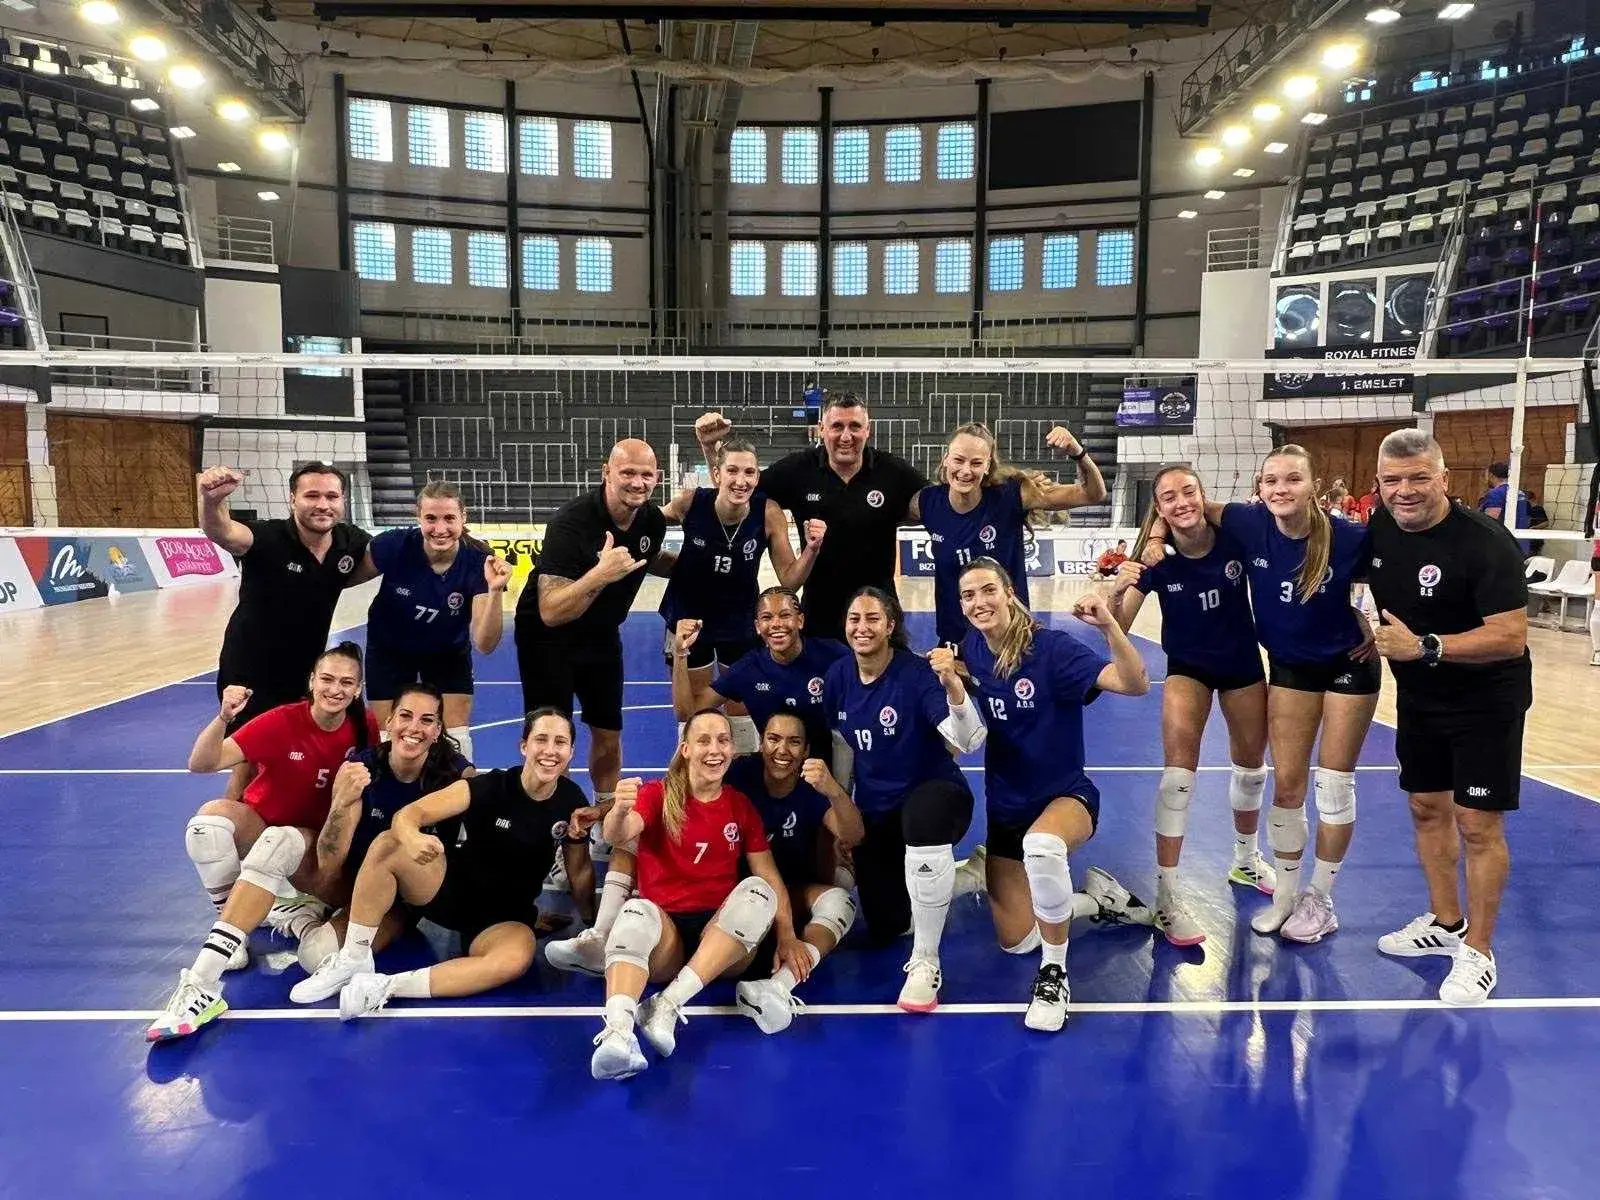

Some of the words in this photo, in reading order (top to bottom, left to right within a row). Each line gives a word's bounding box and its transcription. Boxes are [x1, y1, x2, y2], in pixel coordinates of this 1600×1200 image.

[1325, 349, 1367, 359] ROYAL
[1341, 381, 1350, 390] 1.
[714, 556, 732, 573] 13
[1199, 589, 1220, 611] 10
[1280, 581, 1293, 602] 3
[414, 605, 439, 623] 77
[988, 697, 1007, 721] 12
[854, 729, 873, 751] 19
[315, 769, 329, 788] 5
[693, 842, 708, 864] 7
